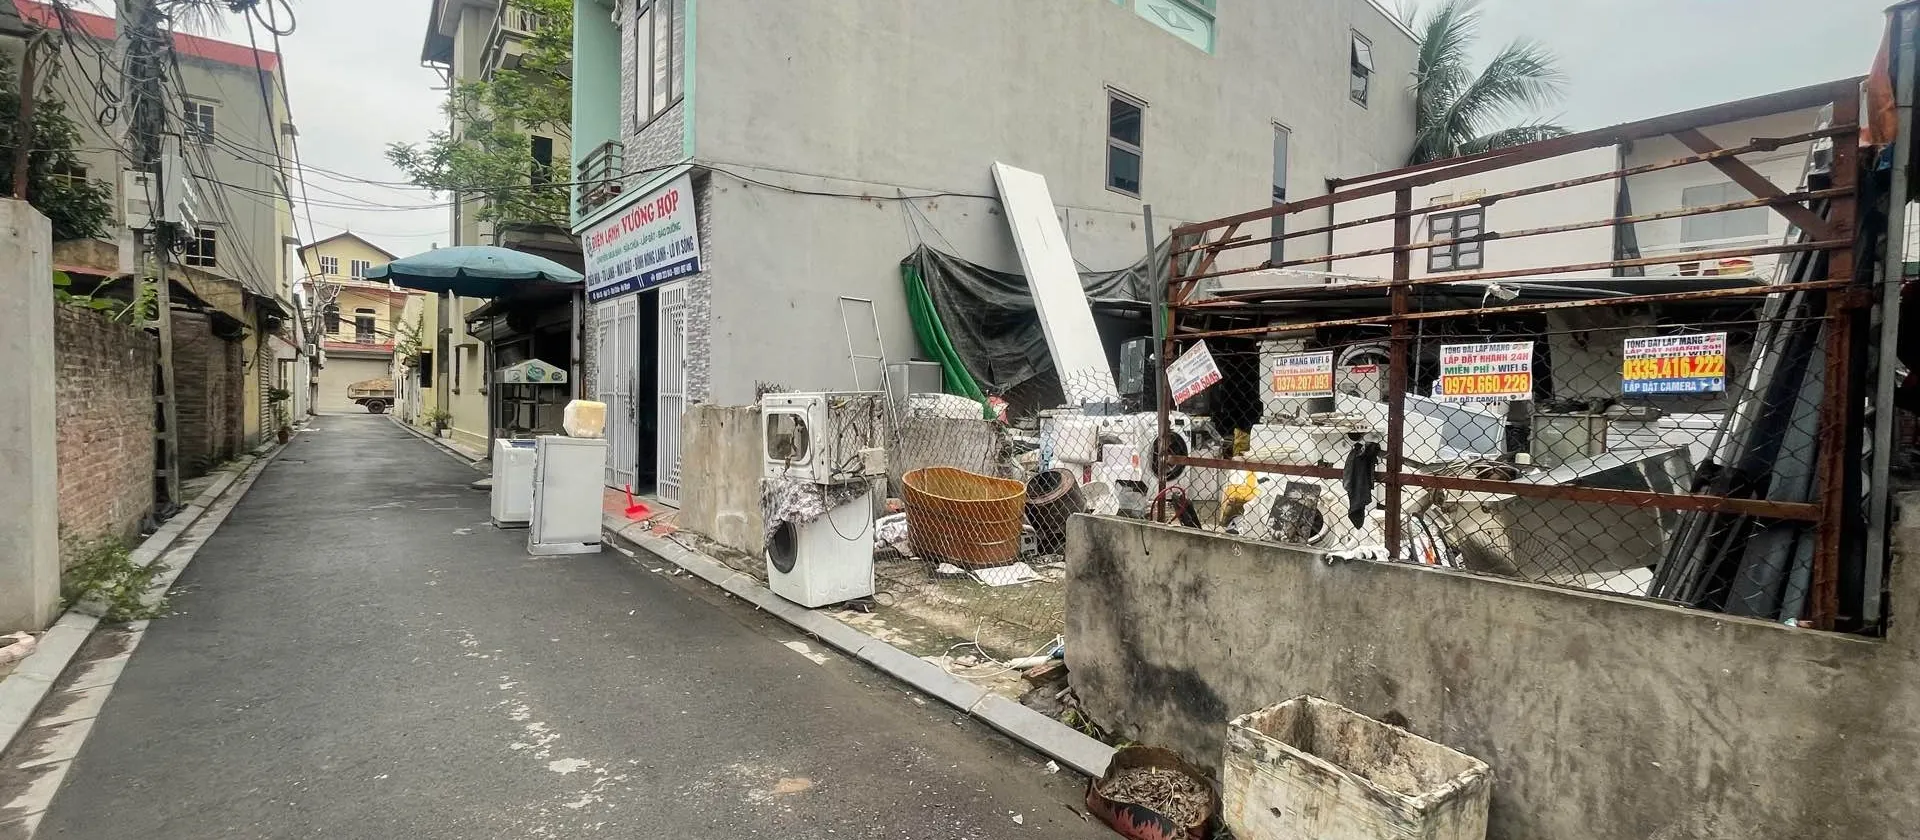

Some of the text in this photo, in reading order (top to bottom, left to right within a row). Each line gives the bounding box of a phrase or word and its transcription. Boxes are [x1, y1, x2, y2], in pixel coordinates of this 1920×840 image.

[622, 203, 655, 234] VƯƠNG
[656, 189, 679, 220] HỢP
[1444, 352, 1529, 365] LẮP ĐẶT NHANH 24H
[1498, 364, 1518, 373] WIFI
[1521, 363, 1528, 371] 6
[1624, 355, 1724, 380] 0335.416.222
[1276, 374, 1329, 391] 0374.207.093
[1444, 374, 1529, 394] 0979.660.228
[1624, 380, 1640, 393] LẮP
[1660, 381, 1697, 392] CAMERA
